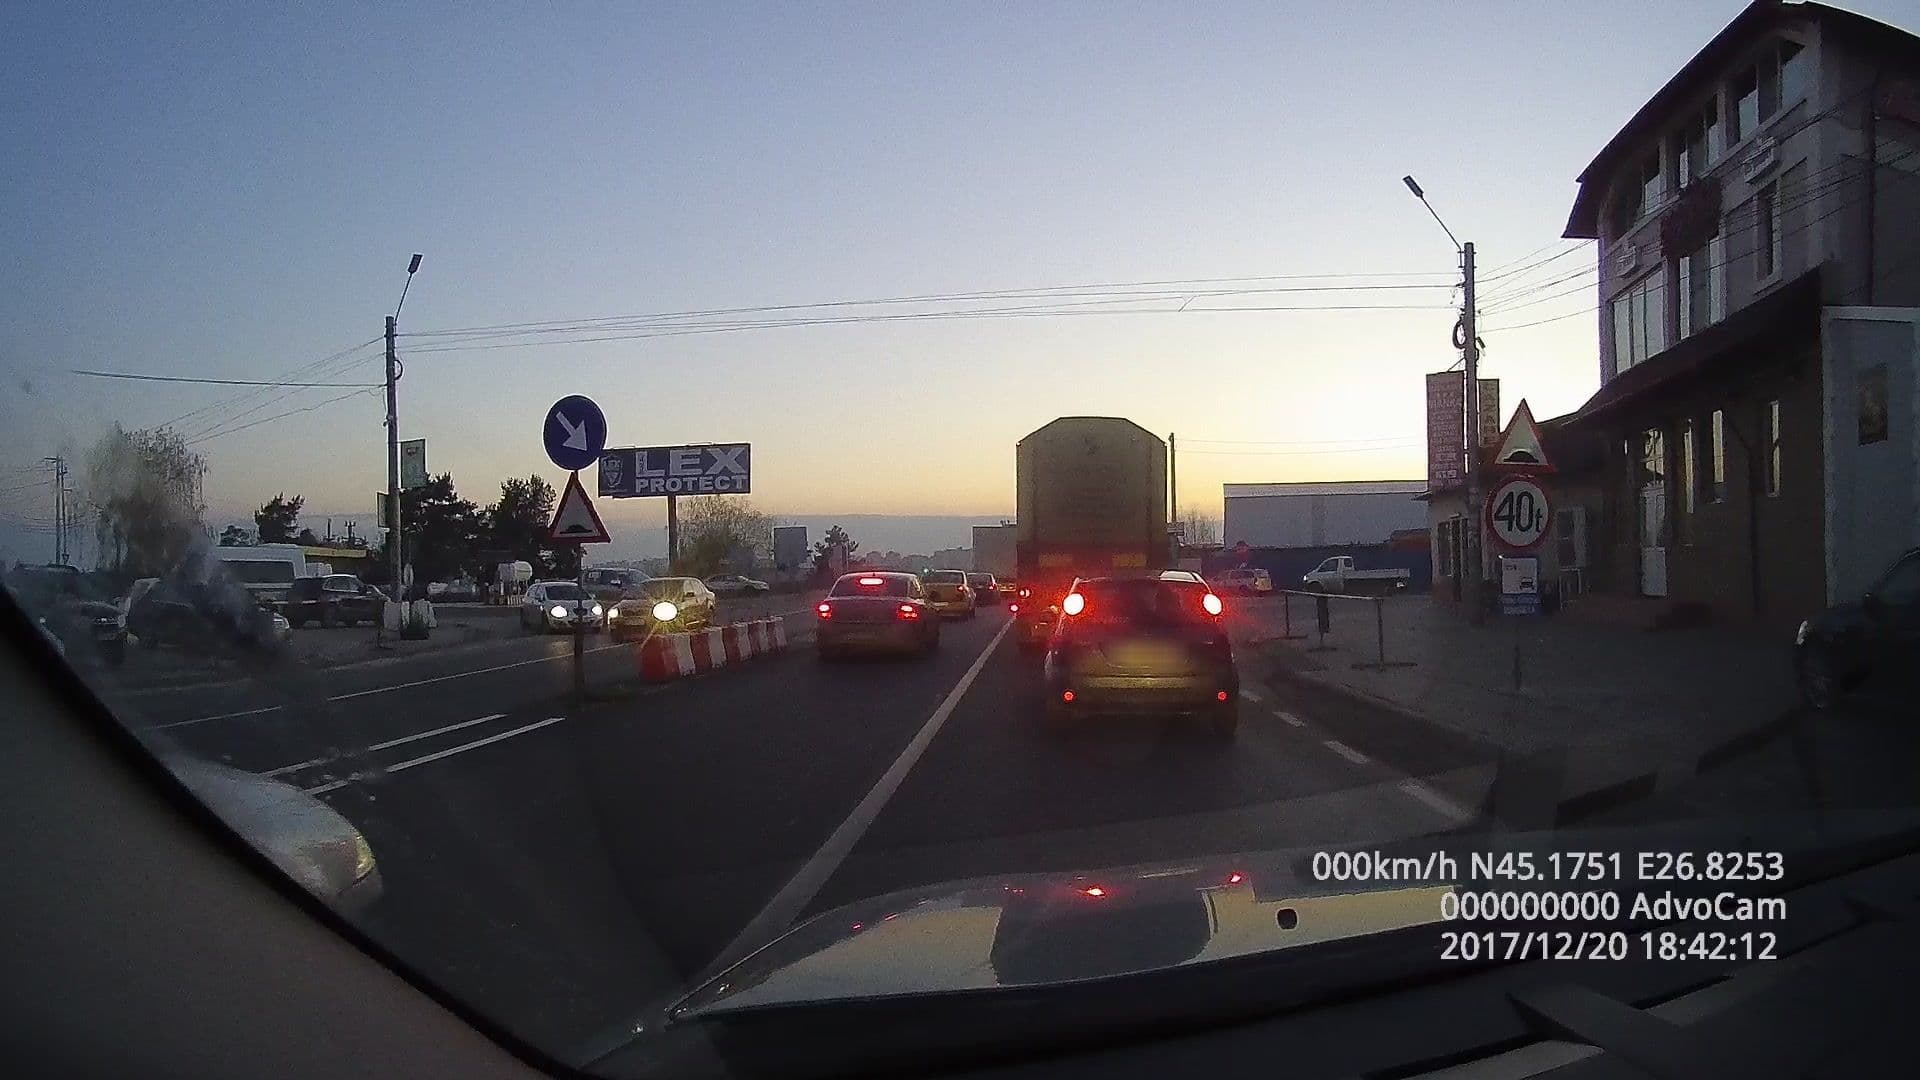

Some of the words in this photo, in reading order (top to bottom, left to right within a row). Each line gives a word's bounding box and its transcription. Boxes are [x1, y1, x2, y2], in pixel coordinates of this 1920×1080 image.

[636, 448, 747, 475] LEX
[636, 477, 748, 493] PROTECT
[1494, 491, 1543, 533] 40t
